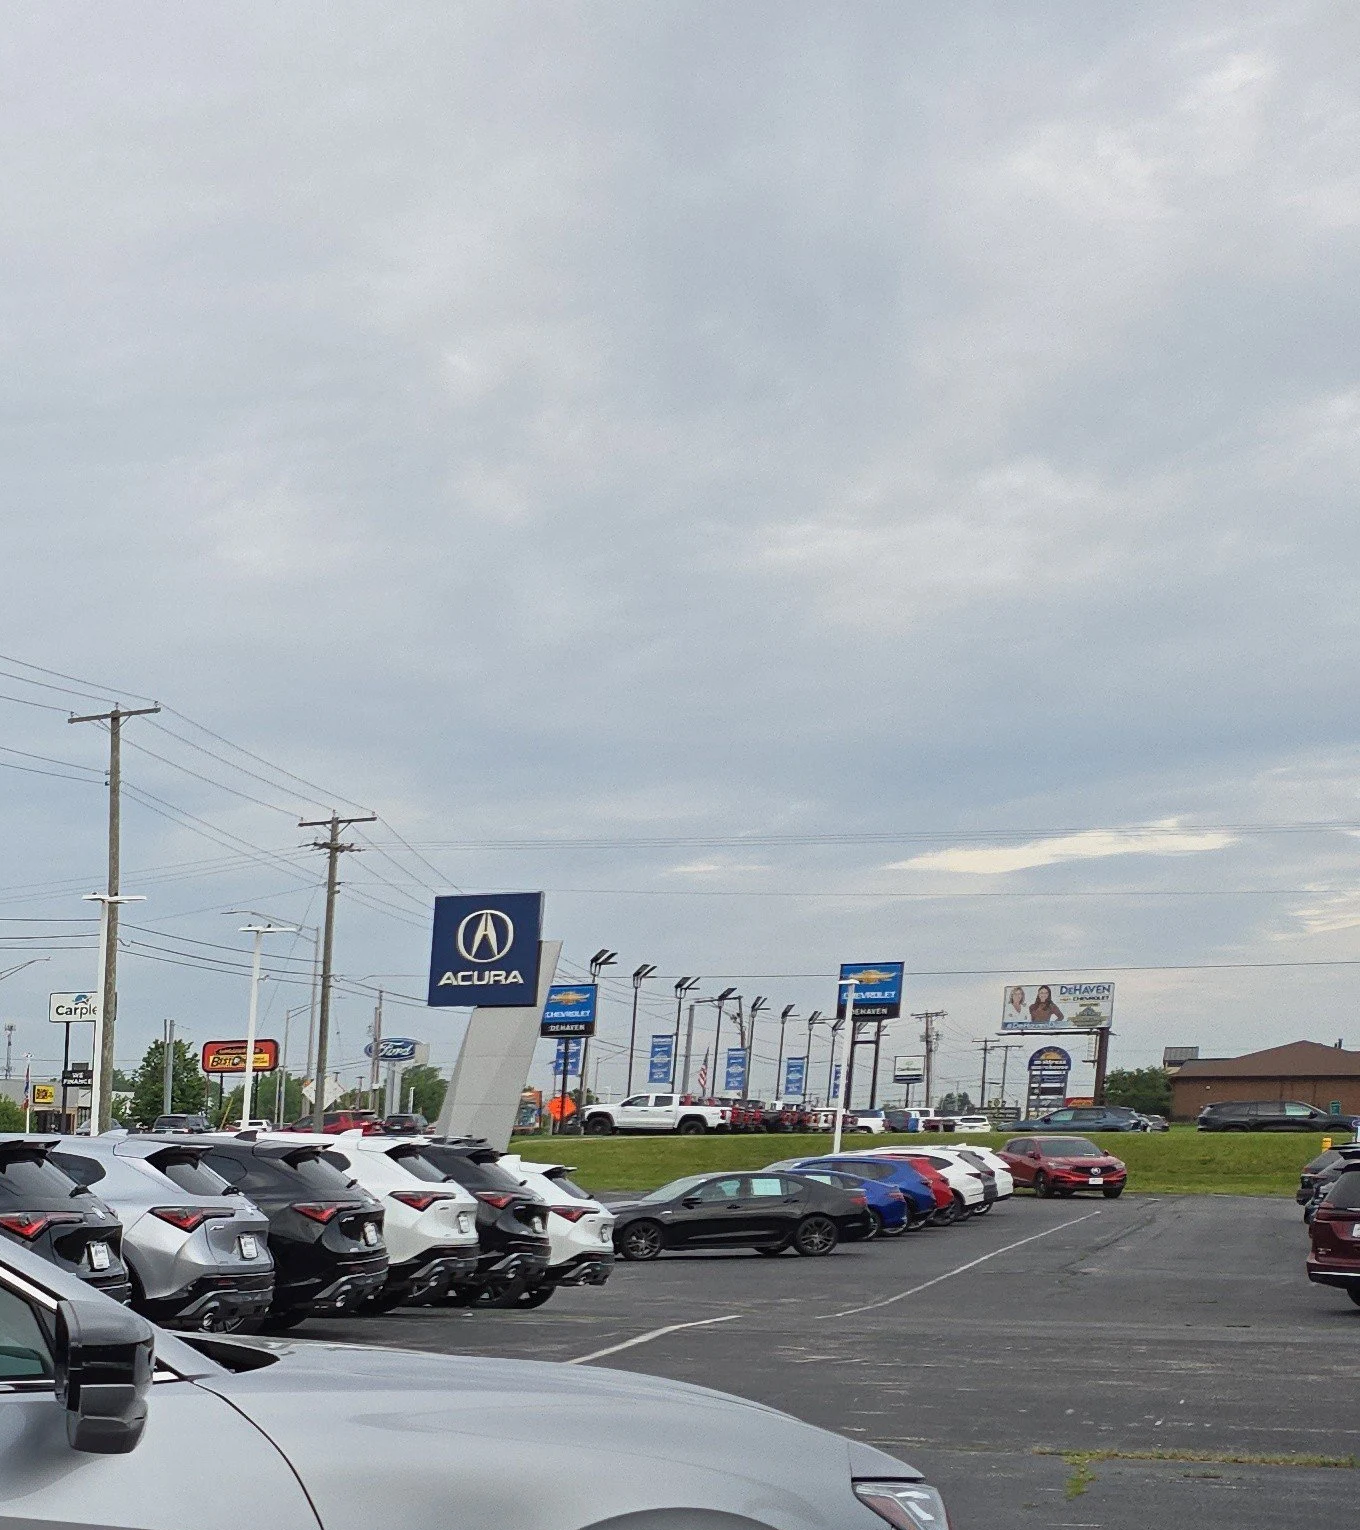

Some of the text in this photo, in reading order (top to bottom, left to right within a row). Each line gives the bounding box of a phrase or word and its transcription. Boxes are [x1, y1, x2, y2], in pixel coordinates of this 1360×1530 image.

[437, 970, 524, 986] ACURA
[842, 991, 896, 999] CEVROLET
[545, 1010, 590, 1018] CHEVROLET
